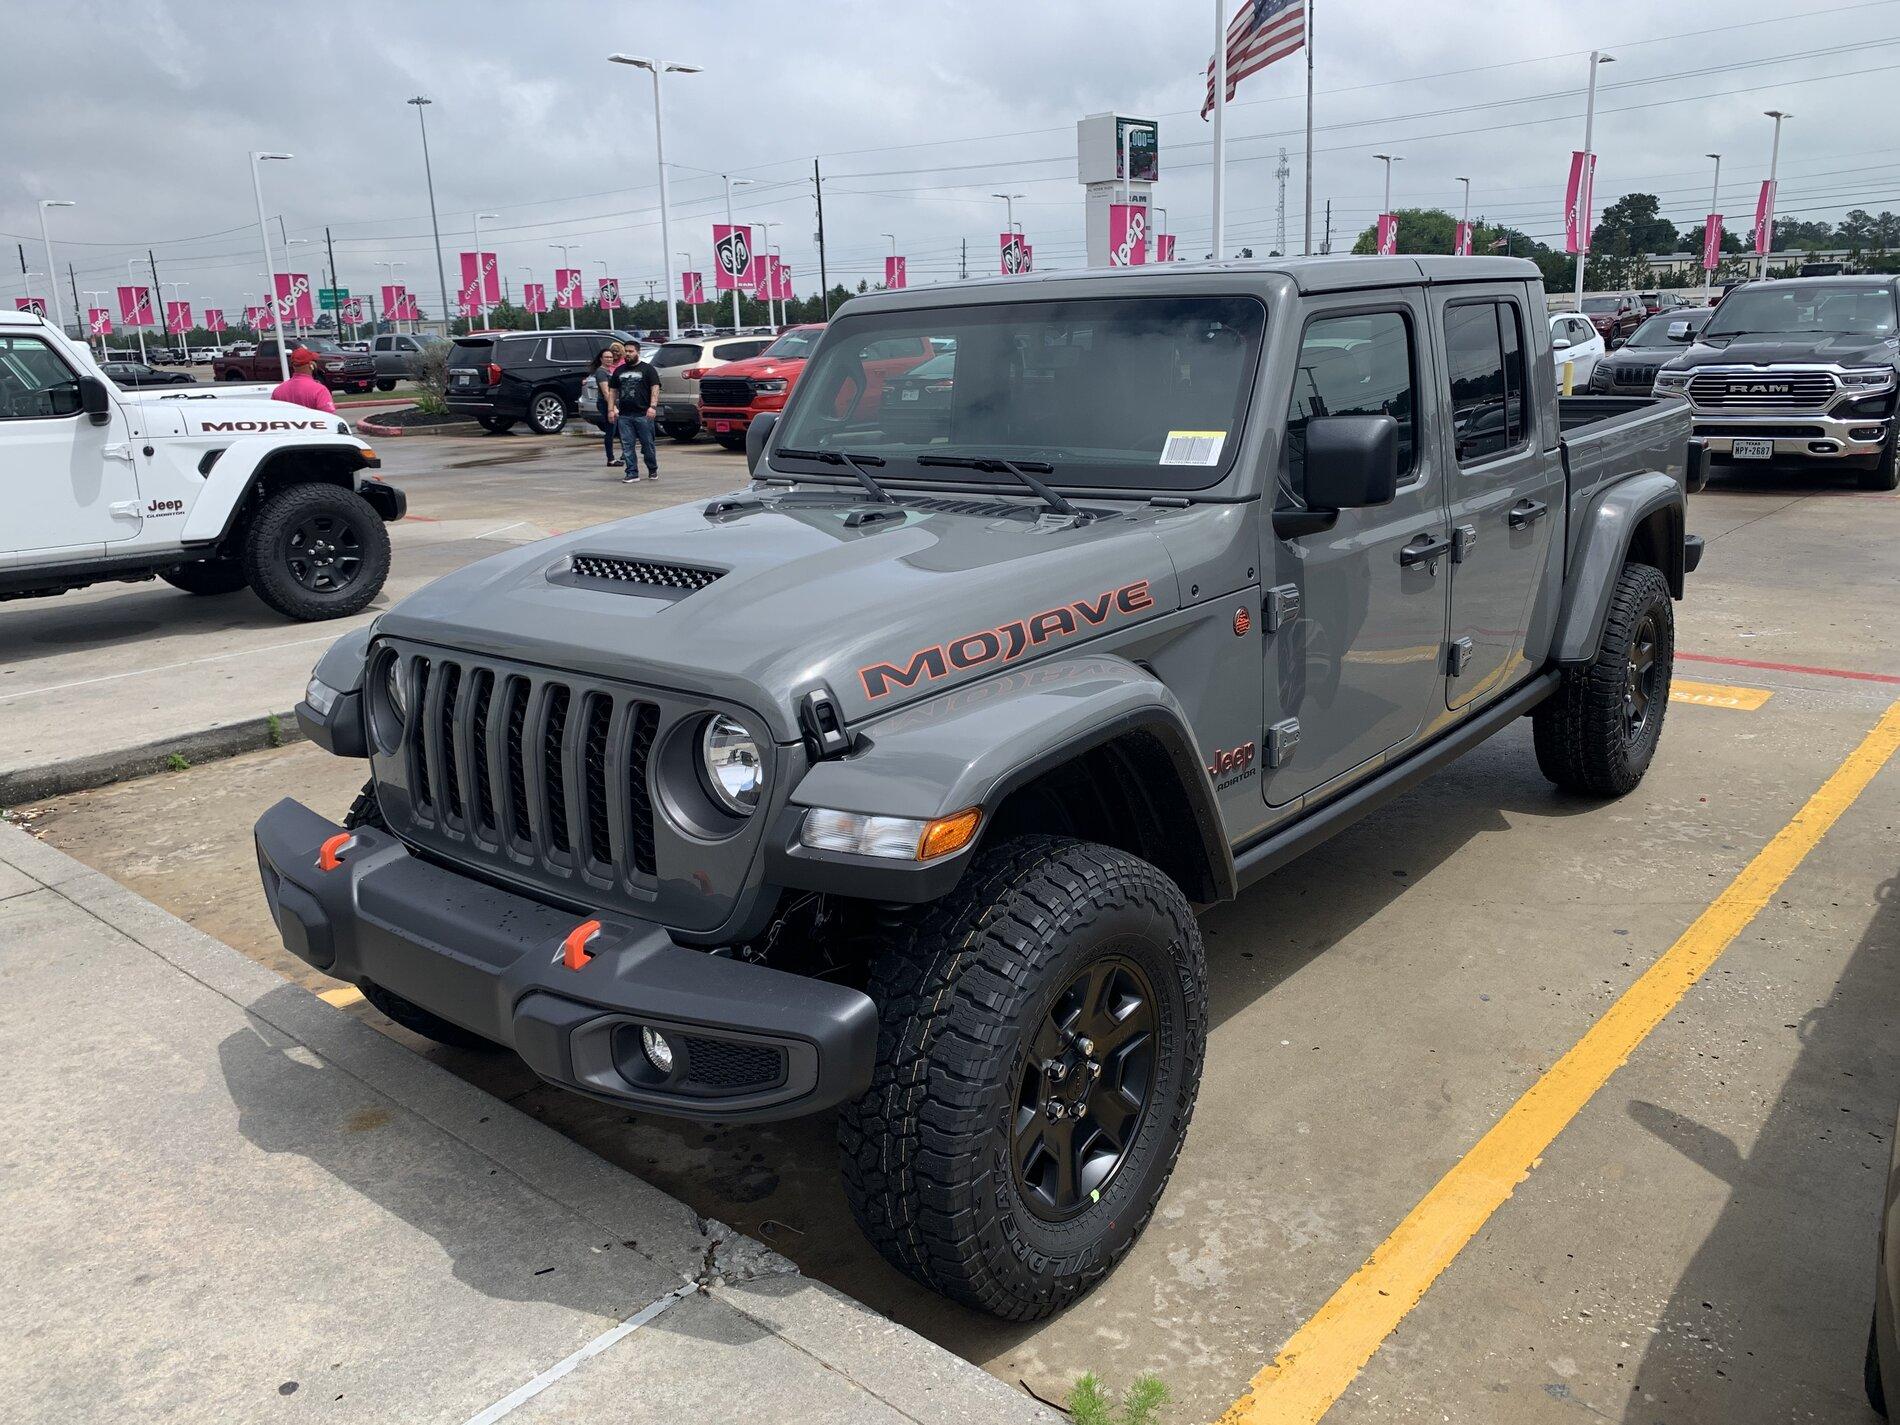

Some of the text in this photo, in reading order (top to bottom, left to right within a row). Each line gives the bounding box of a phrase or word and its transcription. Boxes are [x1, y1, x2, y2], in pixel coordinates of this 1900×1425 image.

[1129, 195, 1147, 203] AM
[465, 258, 496, 300] CHRYLER
[559, 272, 580, 305] Jeep
[757, 260, 779, 296] CHRYLER
[278, 277, 308, 315] Jeep
[91, 311, 109, 333] Jeep
[1730, 384, 1788, 392] RAM
[201, 421, 328, 433] MOJAVE
[147, 499, 183, 512] Jeep
[859, 580, 1154, 699] MOJAVE
[1208, 741, 1256, 776] Jeep
[1215, 768, 1256, 792] ADIATOR
